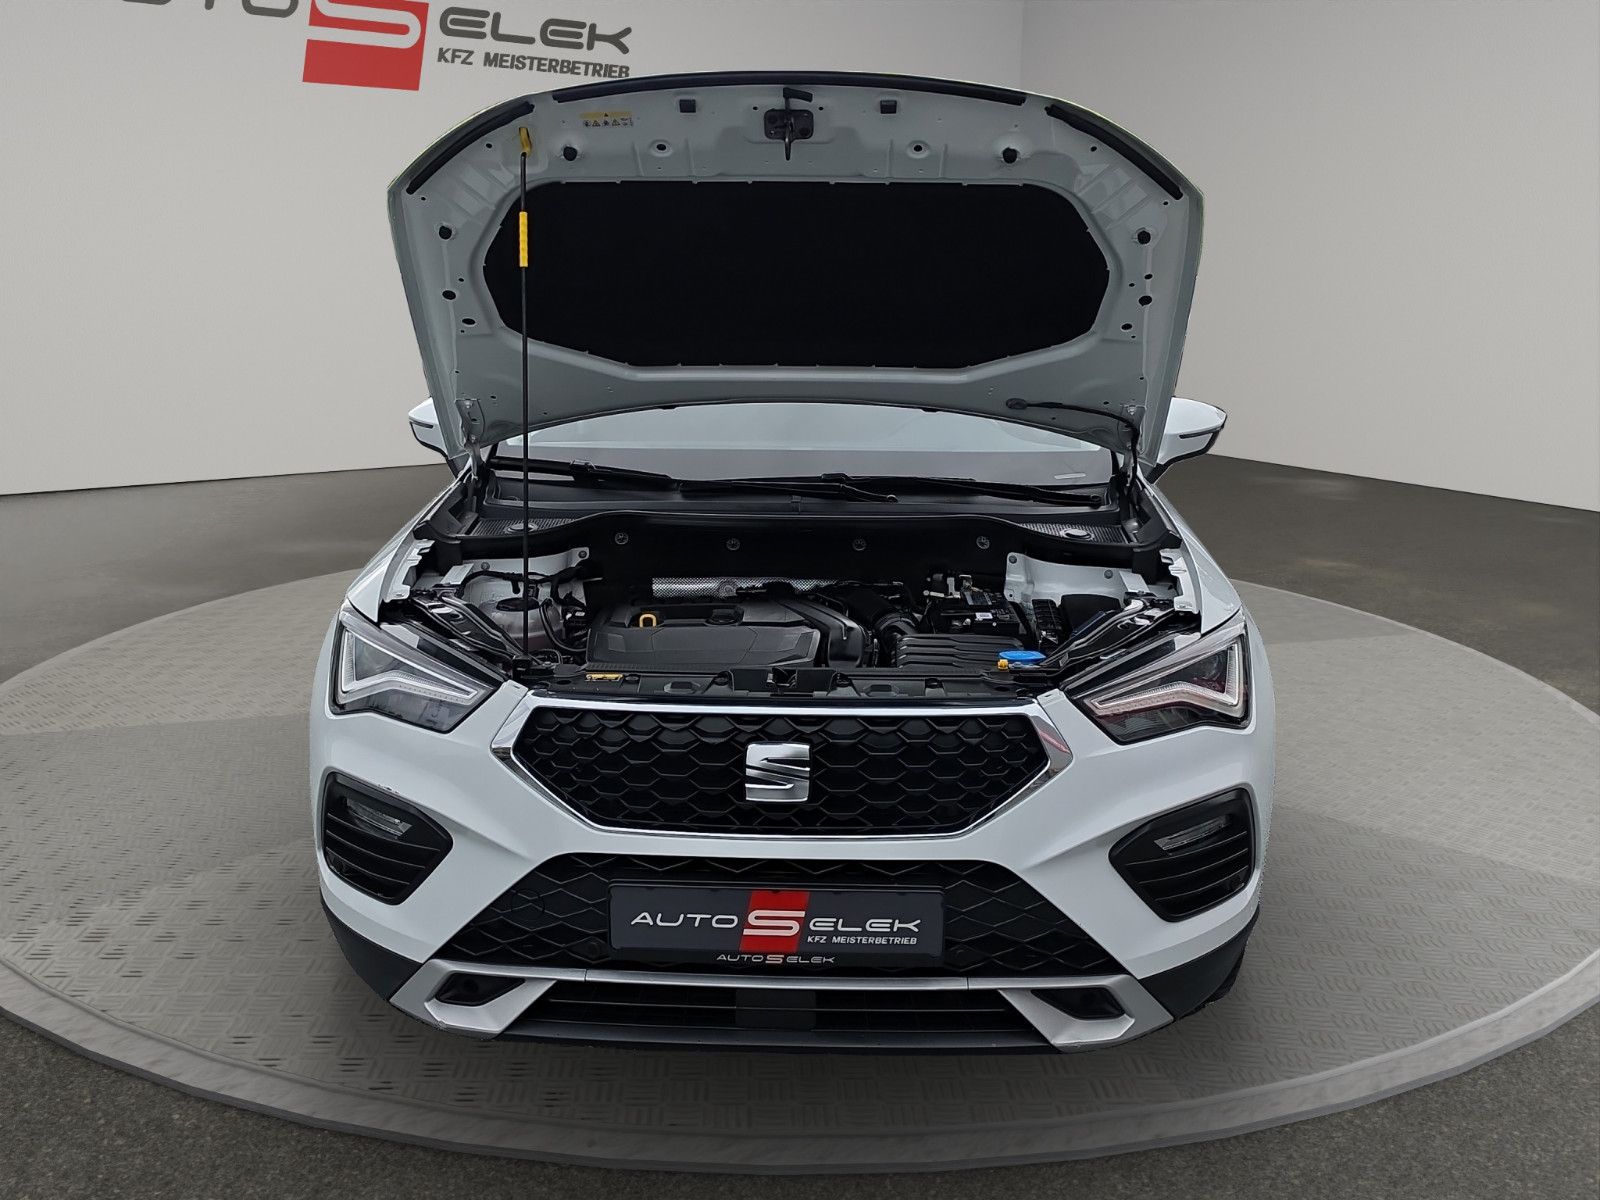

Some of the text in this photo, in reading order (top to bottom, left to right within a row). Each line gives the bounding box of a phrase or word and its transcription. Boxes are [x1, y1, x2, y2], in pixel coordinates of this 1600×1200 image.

[437, 47, 630, 79] KFZ MEISTERBETRIEB
[807, 935, 918, 946] KFZ MEISTERBETRIEB
